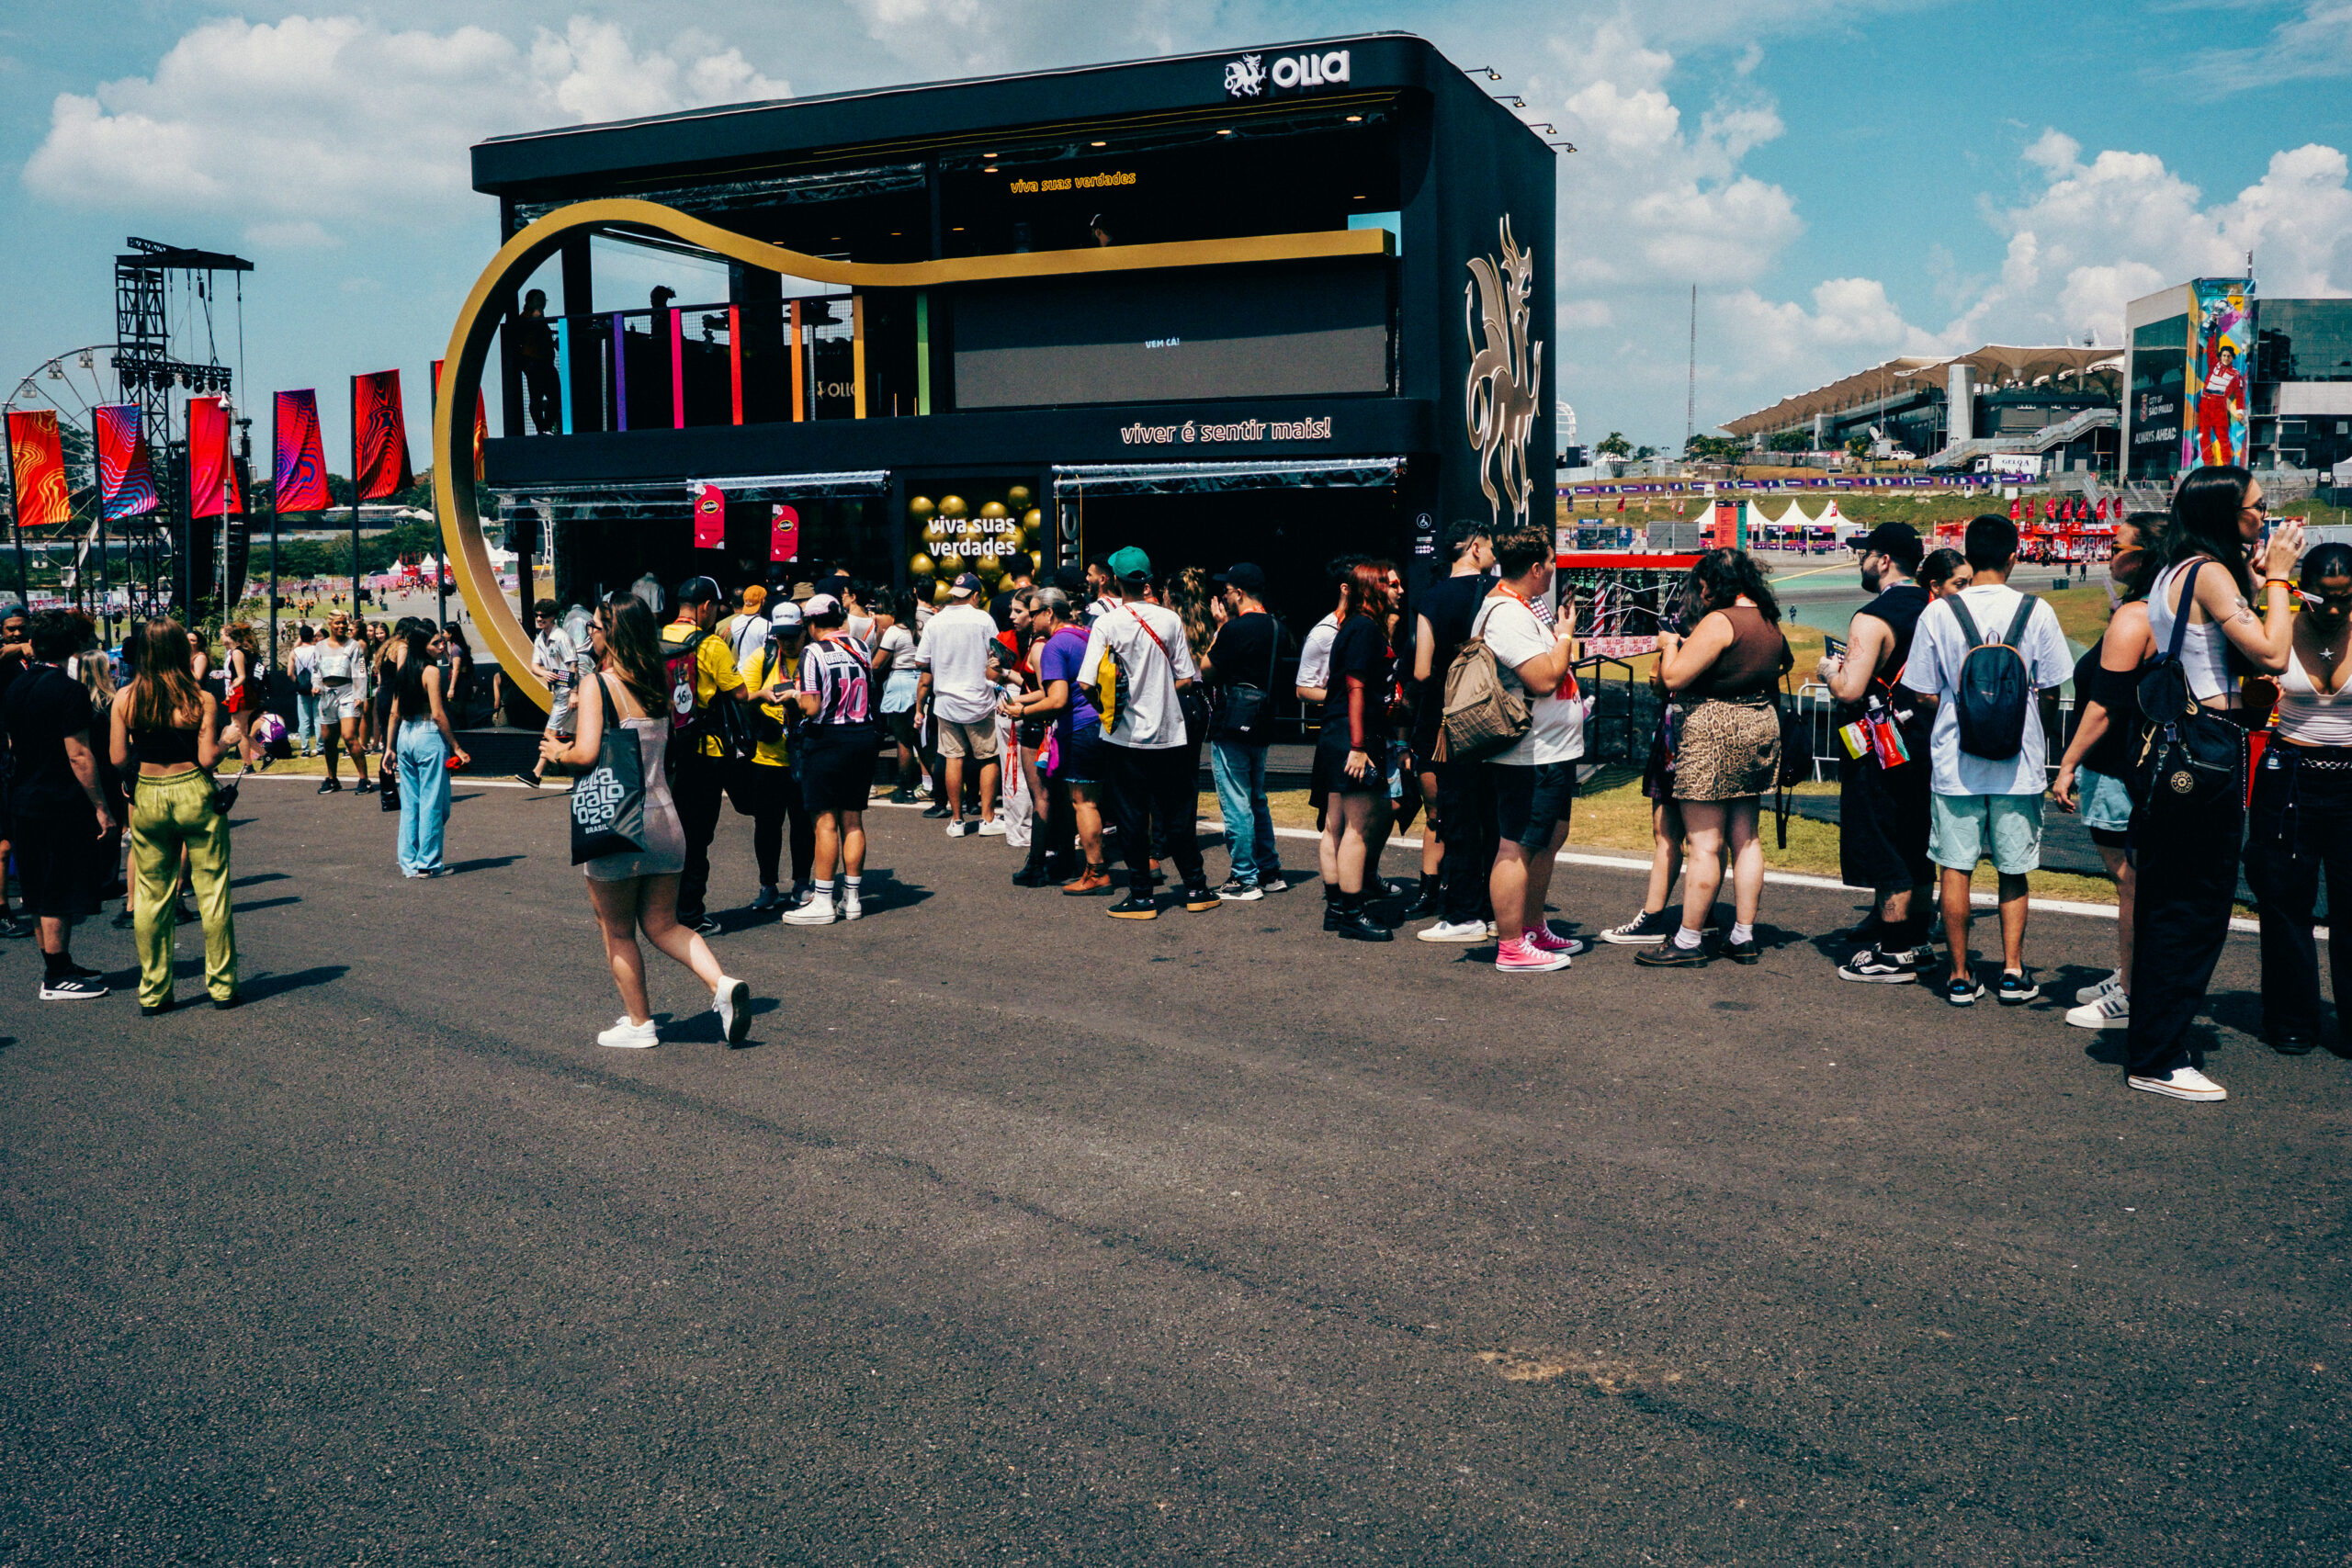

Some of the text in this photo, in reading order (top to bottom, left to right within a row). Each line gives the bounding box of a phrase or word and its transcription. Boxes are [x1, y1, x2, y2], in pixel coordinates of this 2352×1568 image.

[1272, 50, 1351, 88] olla
[1011, 171, 1136, 194] viva suas verdades
[1145, 339, 1164, 349] VEM
[2149, 395, 2164, 405] CITY OF
[2158, 402, 2174, 415] PAULO
[1121, 417, 1331, 444] viver é sentir mais!
[2134, 426, 2177, 445] ALWAYS AHEAD
[928, 514, 1016, 535] viva suas
[929, 536, 1016, 557] verdades
[835, 676, 868, 720] 10
[585, 823, 609, 835] BRASIL
